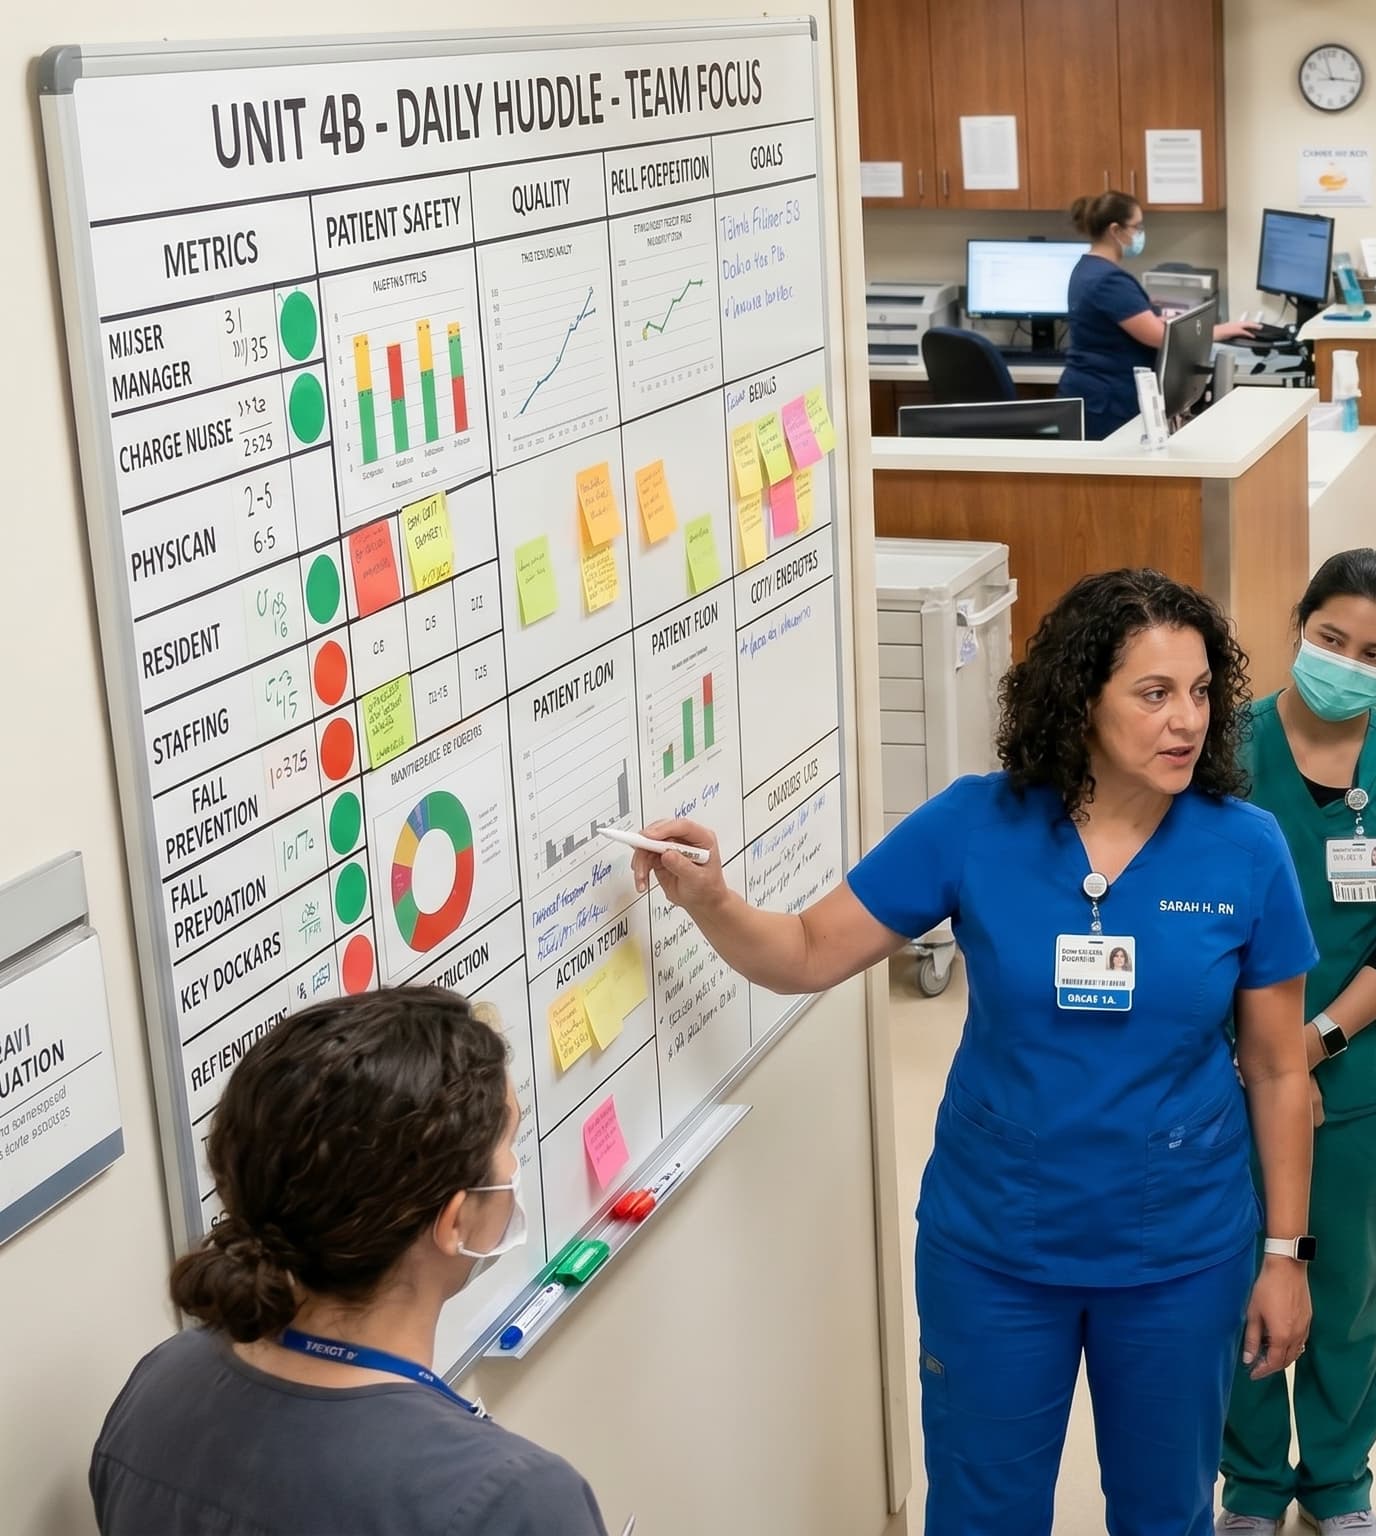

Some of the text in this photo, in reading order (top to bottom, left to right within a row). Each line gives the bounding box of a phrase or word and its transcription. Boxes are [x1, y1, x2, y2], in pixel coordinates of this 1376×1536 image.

[212, 98, 306, 169] UNIT
[319, 94, 367, 155] 4B
[397, 82, 484, 148] DAILY
[495, 72, 605, 137] HUDDLE
[625, 65, 692, 120] TEAM
[698, 59, 763, 112] FOCUS
[750, 142, 784, 171] GOALS
[511, 178, 571, 216] QUALITY
[326, 196, 462, 249] PATIENT SAFETY
[163, 230, 259, 279] METRICS
[112, 361, 193, 402] MANAGER
[119, 432, 183, 474] CHARGE
[131, 526, 218, 582] PHYSICAN
[143, 623, 221, 680] RESIDENT
[652, 616, 692, 656] PATIENT
[533, 679, 581, 722] PATIENT
[153, 707, 230, 765] STAFFING
[191, 776, 228, 814] FALL
[165, 794, 260, 865] PREVENTION
[170, 874, 208, 914] FALL
[174, 875, 267, 949] PREPOATION
[1159, 900, 1235, 915] SARAH H. RN
[180, 973, 210, 1014] KEY
[213, 931, 282, 993] DOCKARS
[556, 943, 595, 990] ACTION
